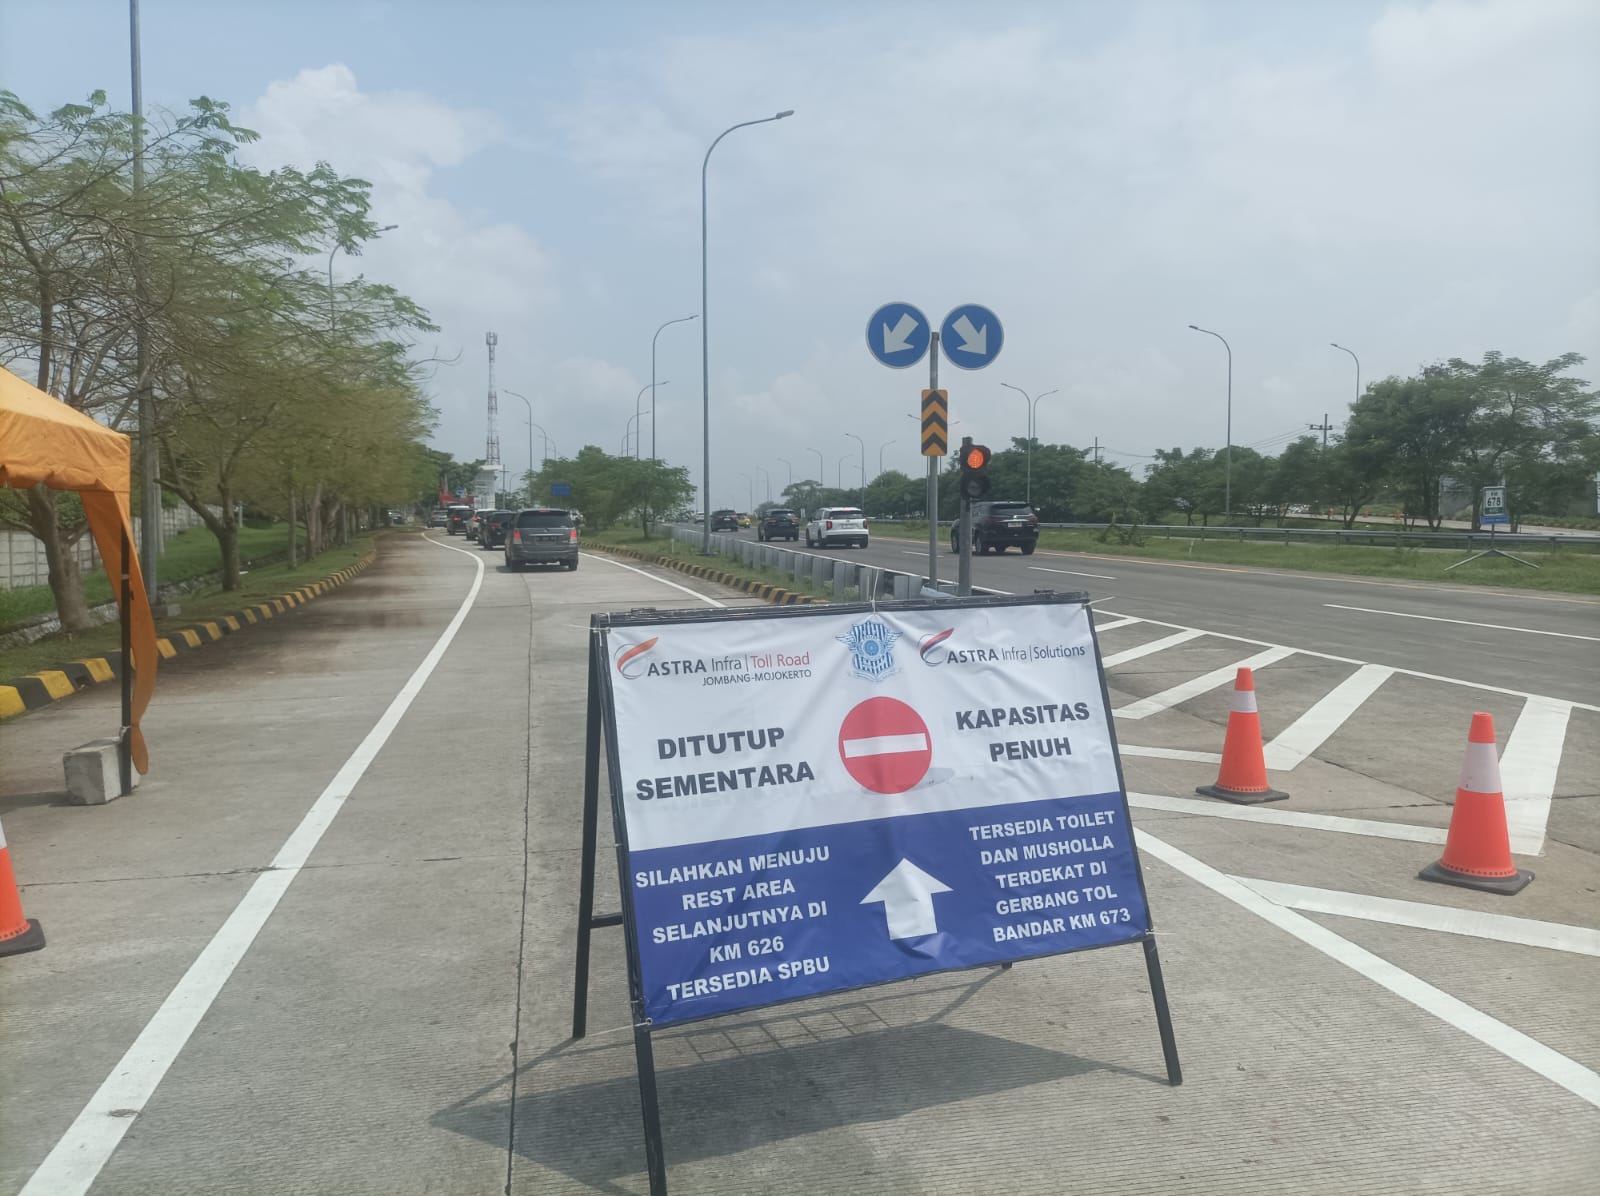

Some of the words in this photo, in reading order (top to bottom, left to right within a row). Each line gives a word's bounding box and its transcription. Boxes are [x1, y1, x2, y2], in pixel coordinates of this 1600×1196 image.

[648, 659, 707, 676] ASTRA
[711, 656, 742, 672] Infra
[752, 654, 772, 668] Toll
[777, 652, 810, 667] Road
[947, 648, 999, 664] ASTRA
[1002, 646, 1027, 661] Infra
[1034, 644, 1085, 659] Solutions
[702, 669, 812, 686] JOMBANG-MOJOKERTO
[956, 702, 1090, 730] KAPASITAS
[658, 727, 785, 759] DITUTUP
[989, 737, 1072, 762] PENUH
[636, 761, 815, 801] SEMENTARA
[969, 818, 1054, 841] TERSEDIA
[1056, 810, 1115, 830] TOILET
[980, 848, 1018, 865] DAN
[1024, 836, 1114, 861] MUSHOLLA
[635, 859, 743, 888] SILAHKAN
[749, 846, 830, 872] MENUJU
[995, 864, 1084, 888] TERDEKAT
[1090, 860, 1108, 876] DI
[682, 887, 736, 910] REST
[743, 878, 796, 900] AREA
[996, 890, 1079, 915] GERBANG
[1082, 885, 1118, 902] TOL
[652, 905, 803, 944] SELANJUTNYA
[808, 900, 828, 918] DI
[993, 918, 1066, 942] BANDAR
[1069, 913, 1096, 930] KM
[1100, 908, 1131, 925] 673
[710, 944, 742, 964] KM
[748, 936, 784, 956] 626
[666, 968, 773, 1000] TERSEDIA
[778, 956, 830, 980] SPBU
